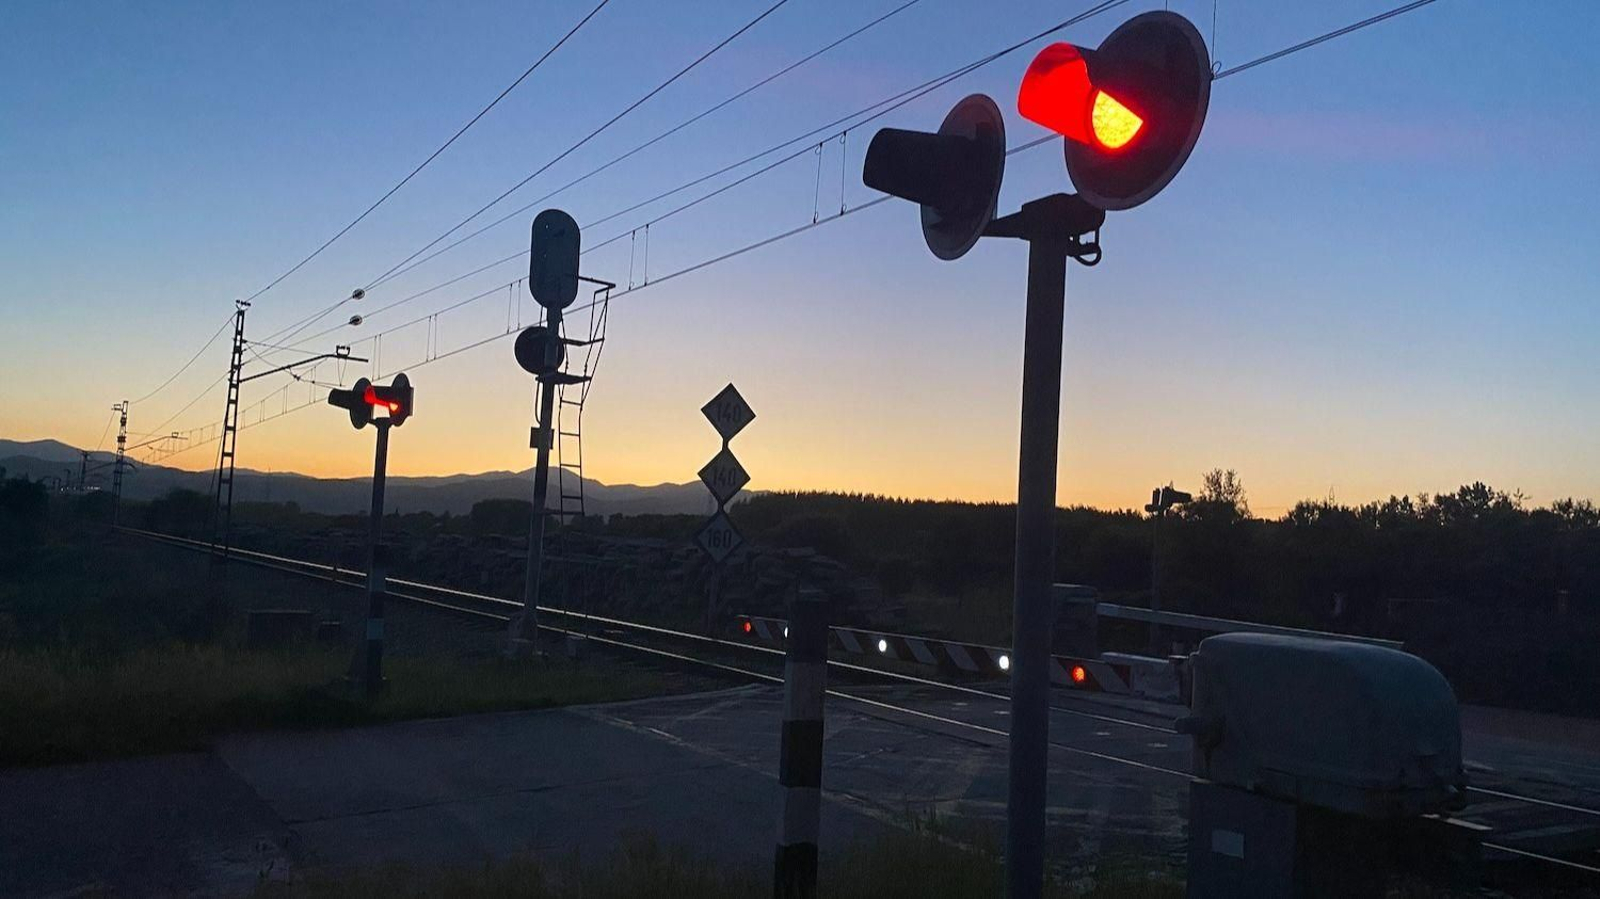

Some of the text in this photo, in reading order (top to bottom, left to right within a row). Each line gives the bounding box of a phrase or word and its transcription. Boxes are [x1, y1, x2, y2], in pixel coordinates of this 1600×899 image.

[715, 401, 741, 423] 140
[713, 466, 736, 487] 140
[707, 529, 732, 549] 160
